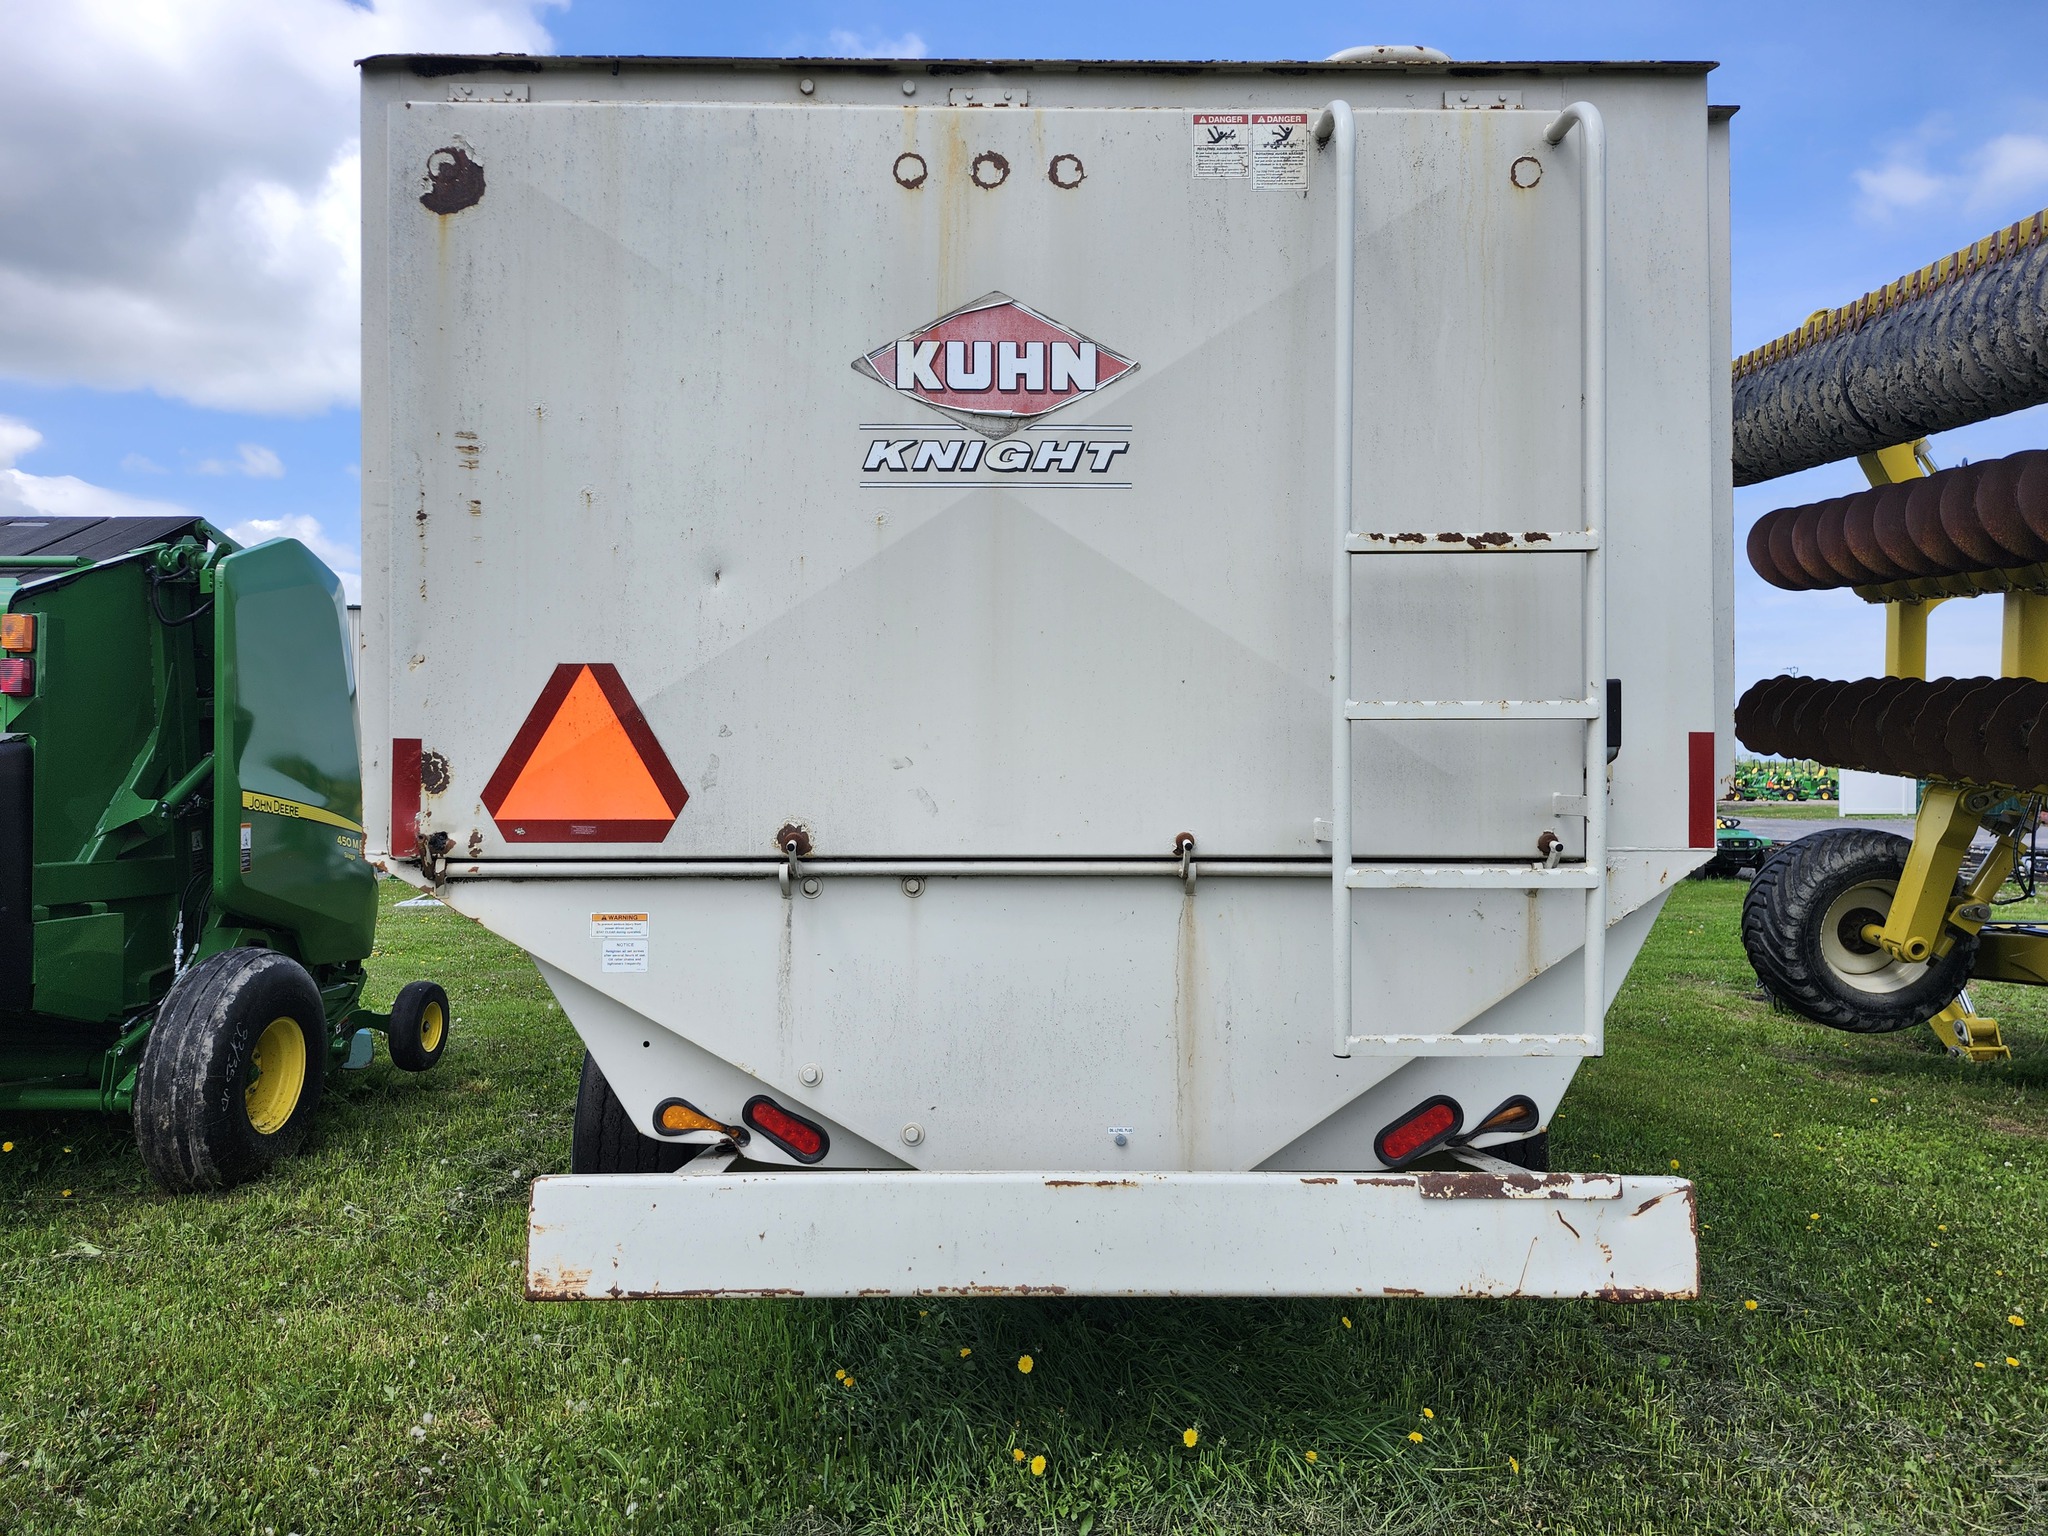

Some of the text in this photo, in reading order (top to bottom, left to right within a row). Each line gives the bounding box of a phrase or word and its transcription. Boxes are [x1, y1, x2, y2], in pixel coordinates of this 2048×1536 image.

[1208, 115, 1243, 123] DANGER
[1266, 115, 1302, 123] DANGER
[896, 340, 1098, 392] KUHN
[862, 439, 1131, 473] KNIGHT
